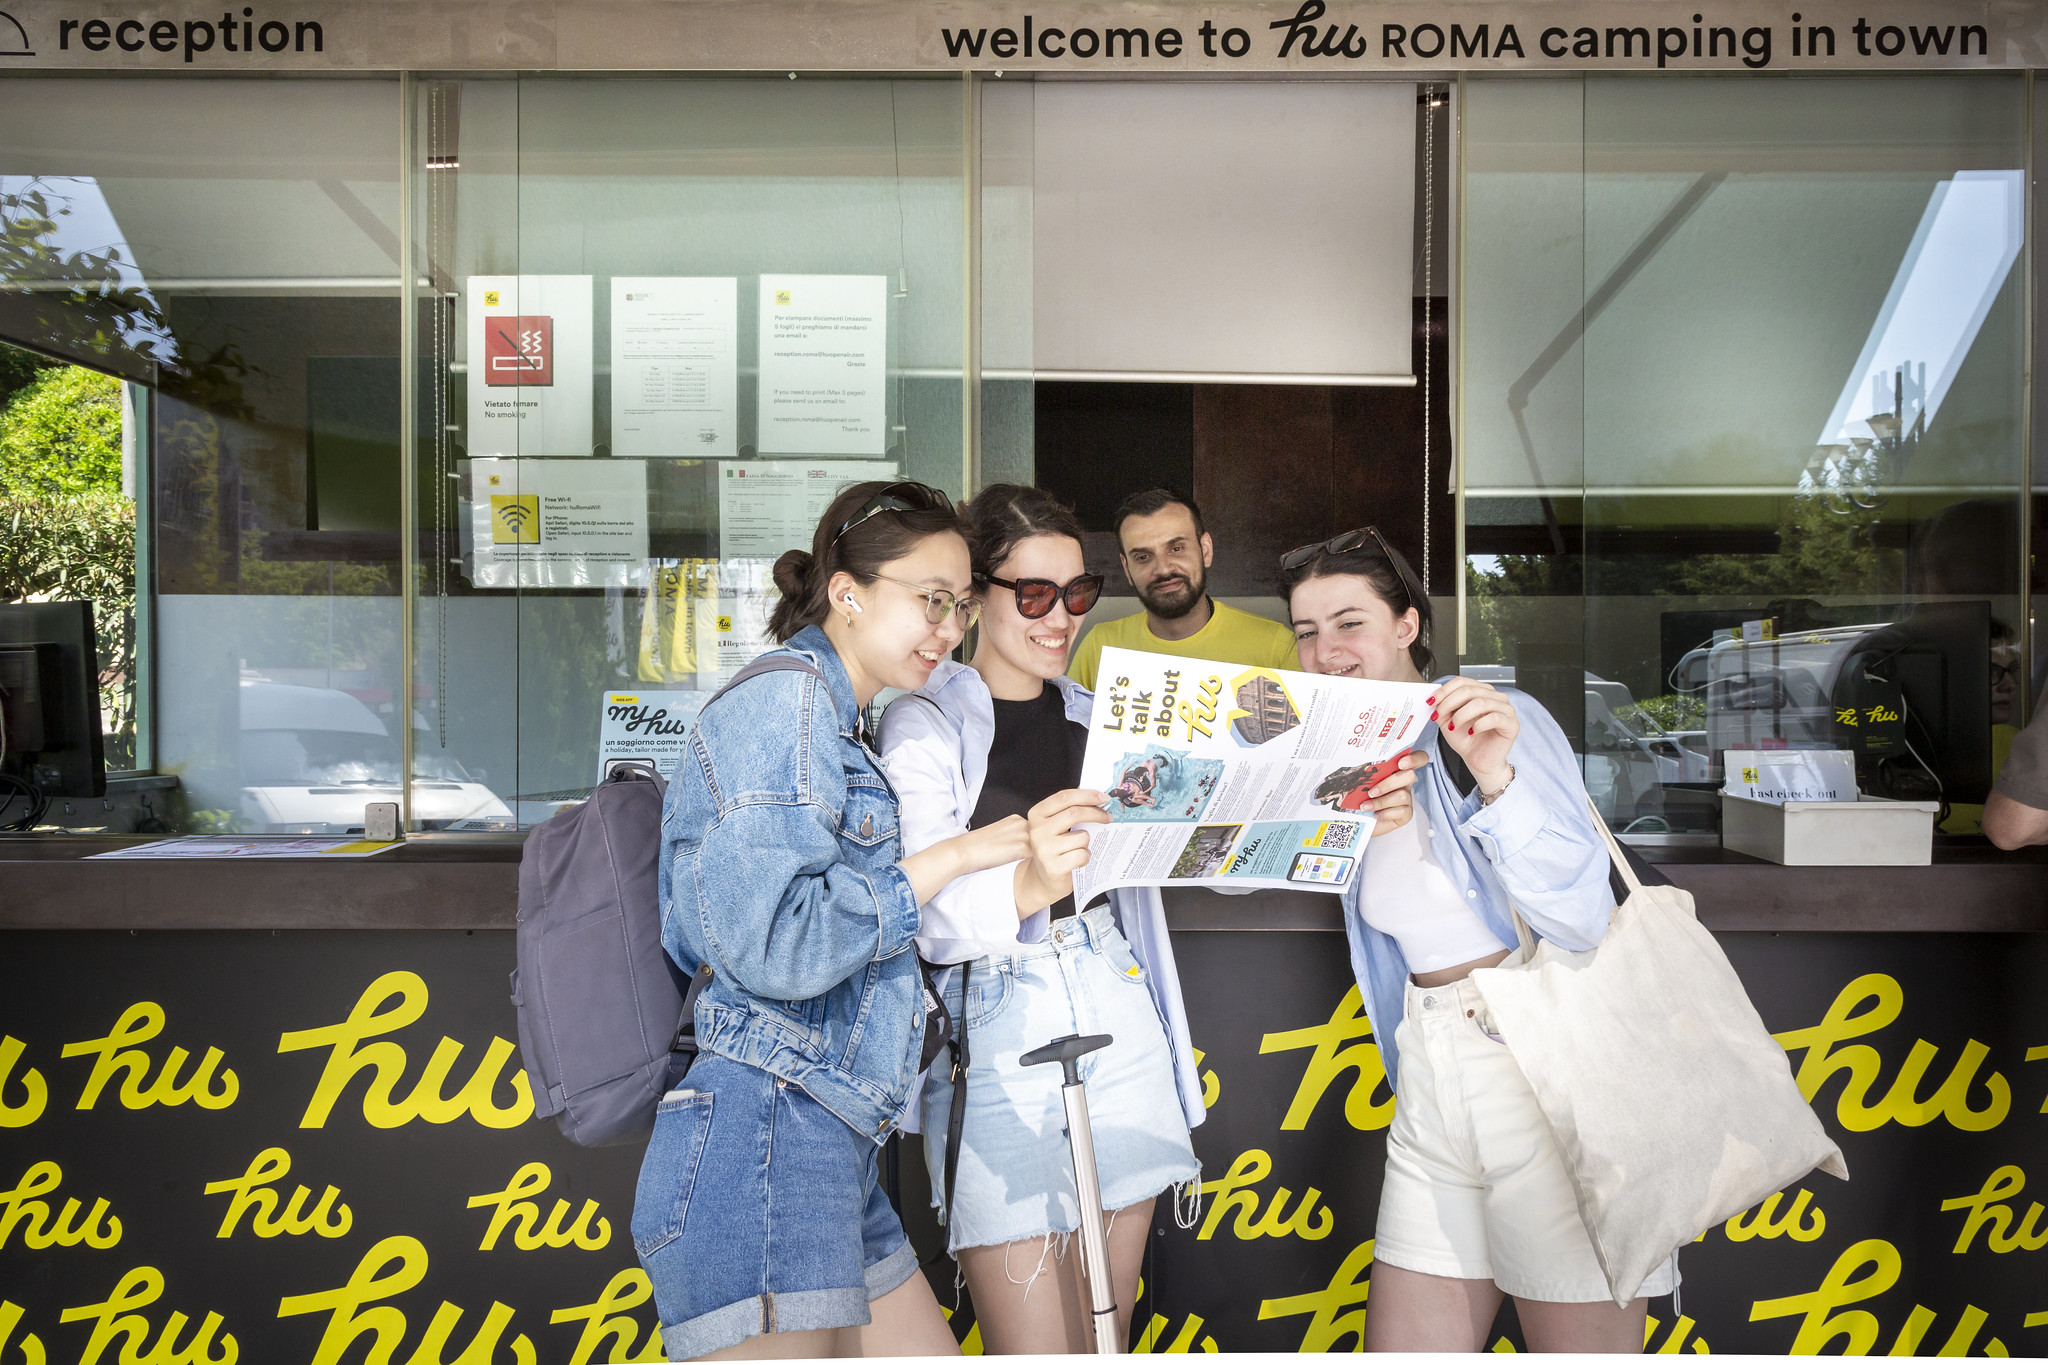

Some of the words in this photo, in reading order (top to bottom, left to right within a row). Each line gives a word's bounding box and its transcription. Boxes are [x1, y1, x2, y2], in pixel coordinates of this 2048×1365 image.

[60, 7, 322, 62] reception
[942, 16, 1182, 58] welcome
[1199, 20, 1250, 58] to
[1270, 0, 1366, 58] hu
[1382, 24, 1525, 58] ROMA
[1540, 14, 1771, 67] camping
[1792, 13, 1834, 57] in
[1853, 17, 1988, 57] town
[785, 315, 812, 323] stampare
[844, 315, 872, 323] (massimo
[485, 400, 511, 408] Vietato
[497, 410, 526, 419] smoking
[1103, 676, 1132, 732] Let's
[1129, 690, 1154, 735] talk
[1153, 669, 1182, 739] about
[1178, 675, 1223, 743] hu
[1347, 708, 1372, 746] S.O.S.
[1381, 720, 1393, 735] 112
[1865, 705, 1899, 723] hu
[610, 746, 634, 754] holiday,
[616, 739, 655, 747] soggiorno
[1776, 787, 1813, 799] check
[1817, 789, 1837, 799] out
[61, 1002, 239, 1109] hu
[277, 971, 535, 1129] hu
[1771, 974, 2011, 1132] hu
[0, 1161, 122, 1249] hu
[204, 1147, 353, 1238] hu
[467, 1162, 611, 1251] hu
[1190, 1149, 1333, 1240] hu
[60, 1266, 238, 1365] hu
[277, 1236, 536, 1365] hu
[1749, 1239, 2010, 1358] hu
